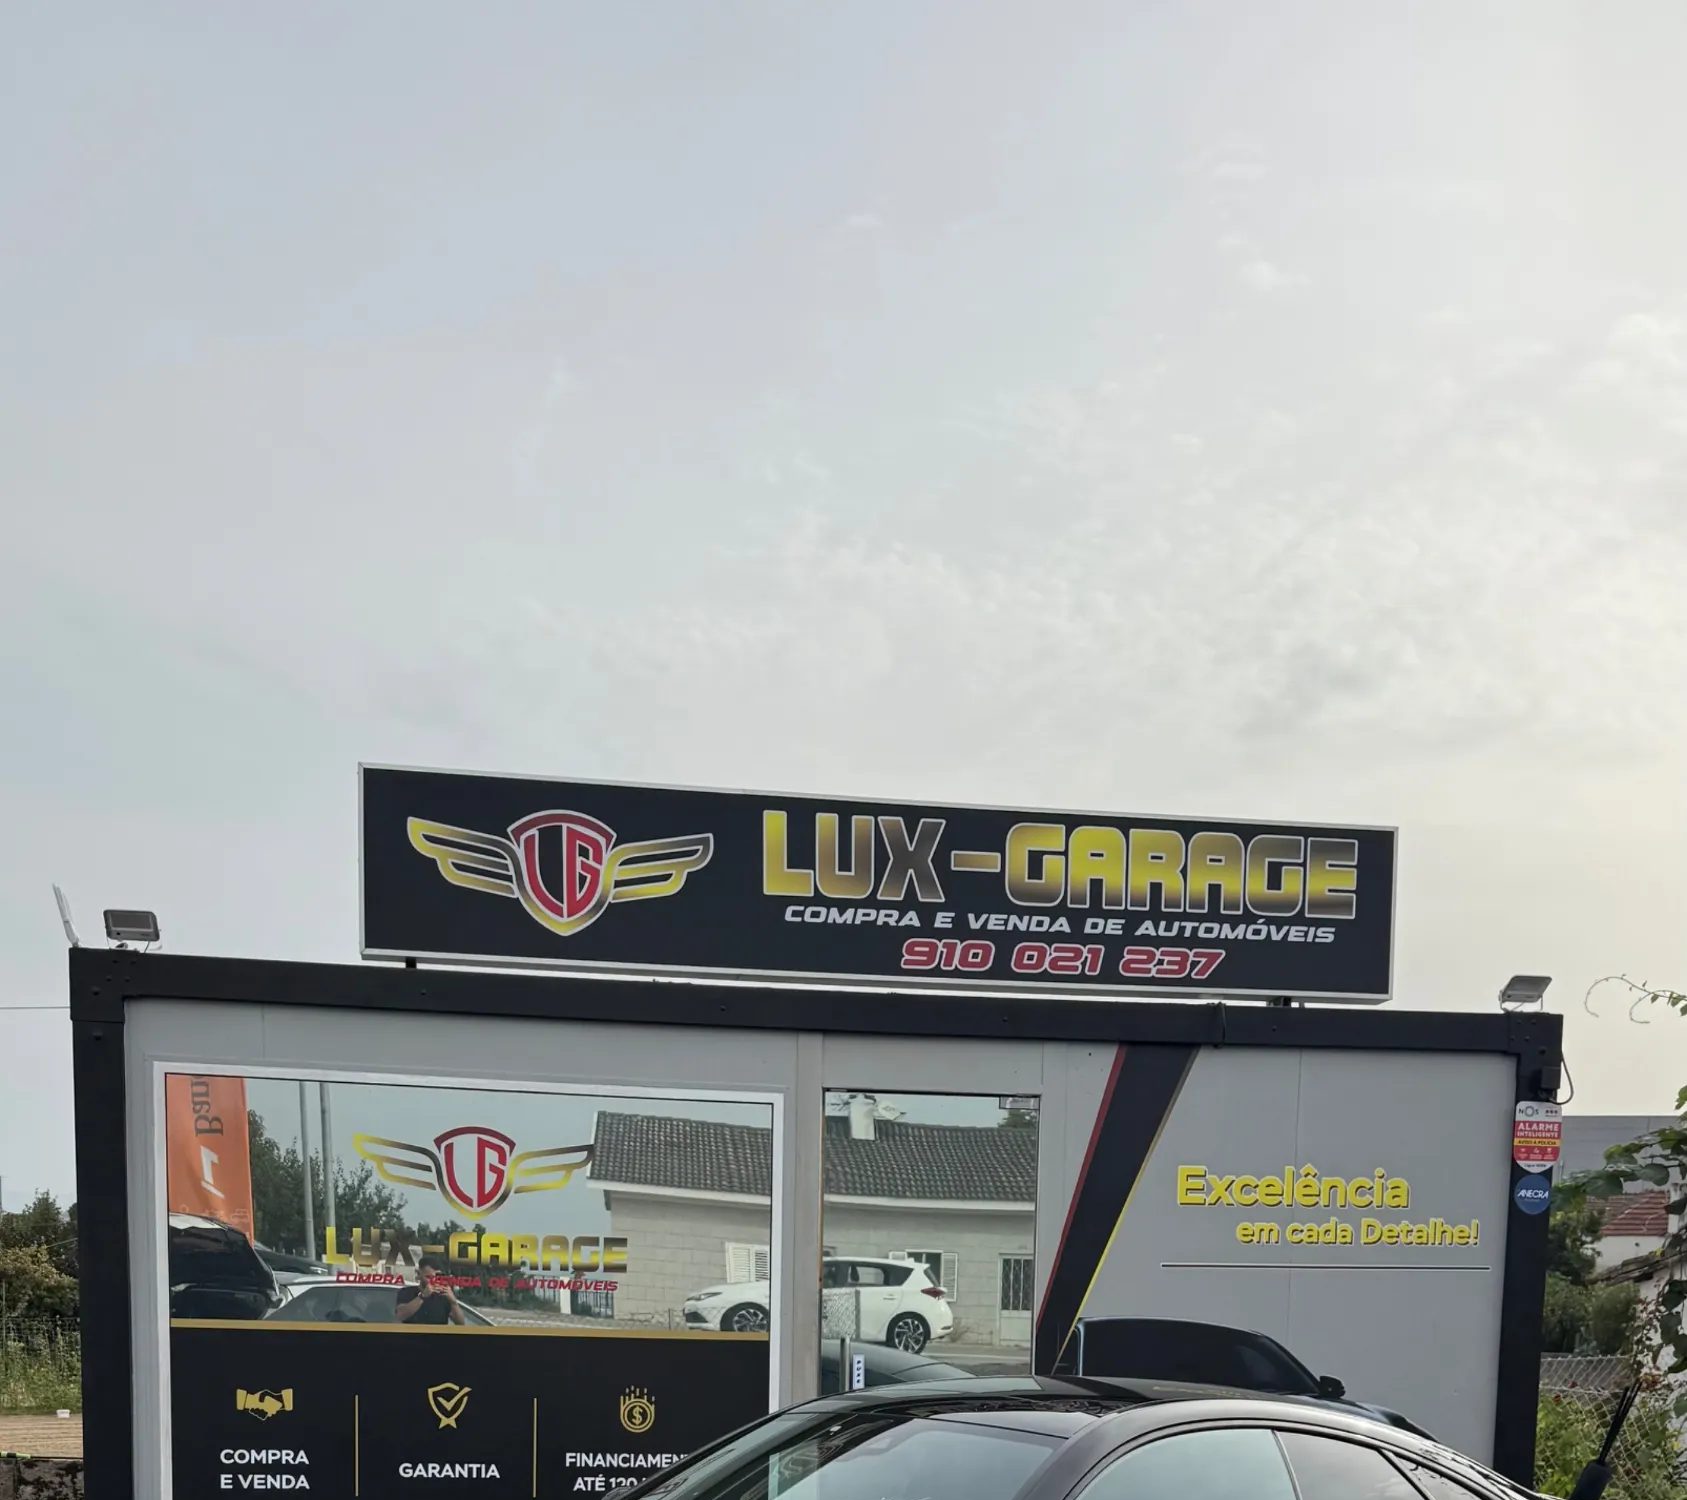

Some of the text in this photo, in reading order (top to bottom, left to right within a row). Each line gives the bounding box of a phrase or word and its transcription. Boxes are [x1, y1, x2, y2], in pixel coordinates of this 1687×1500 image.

[763, 810, 1359, 919] LUX-GARAGE
[784, 905, 1336, 943] COMPRA E VENDA DE AUTOMÓVEIS
[901, 938, 1226, 980] 910 021 237
[1518, 1106, 1539, 1117] NOS
[1518, 1122, 1559, 1132] ALARME
[1176, 1163, 1410, 1209] Excelência
[1517, 1189, 1549, 1199] ANECRA
[1236, 1216, 1480, 1248] em cada Detalhe!
[325, 1226, 628, 1273] LUX-GARAGE
[336, 1270, 618, 1291] COMPRA VENDA DE AUTOMÓVEIS
[220, 1449, 310, 1465] COMPRA
[565, 1452, 688, 1468] FINANCIAMEN
[399, 1462, 501, 1480] GARANTIA
[220, 1474, 310, 1489] E VENDA
[573, 1474, 606, 1491] ATÉ
